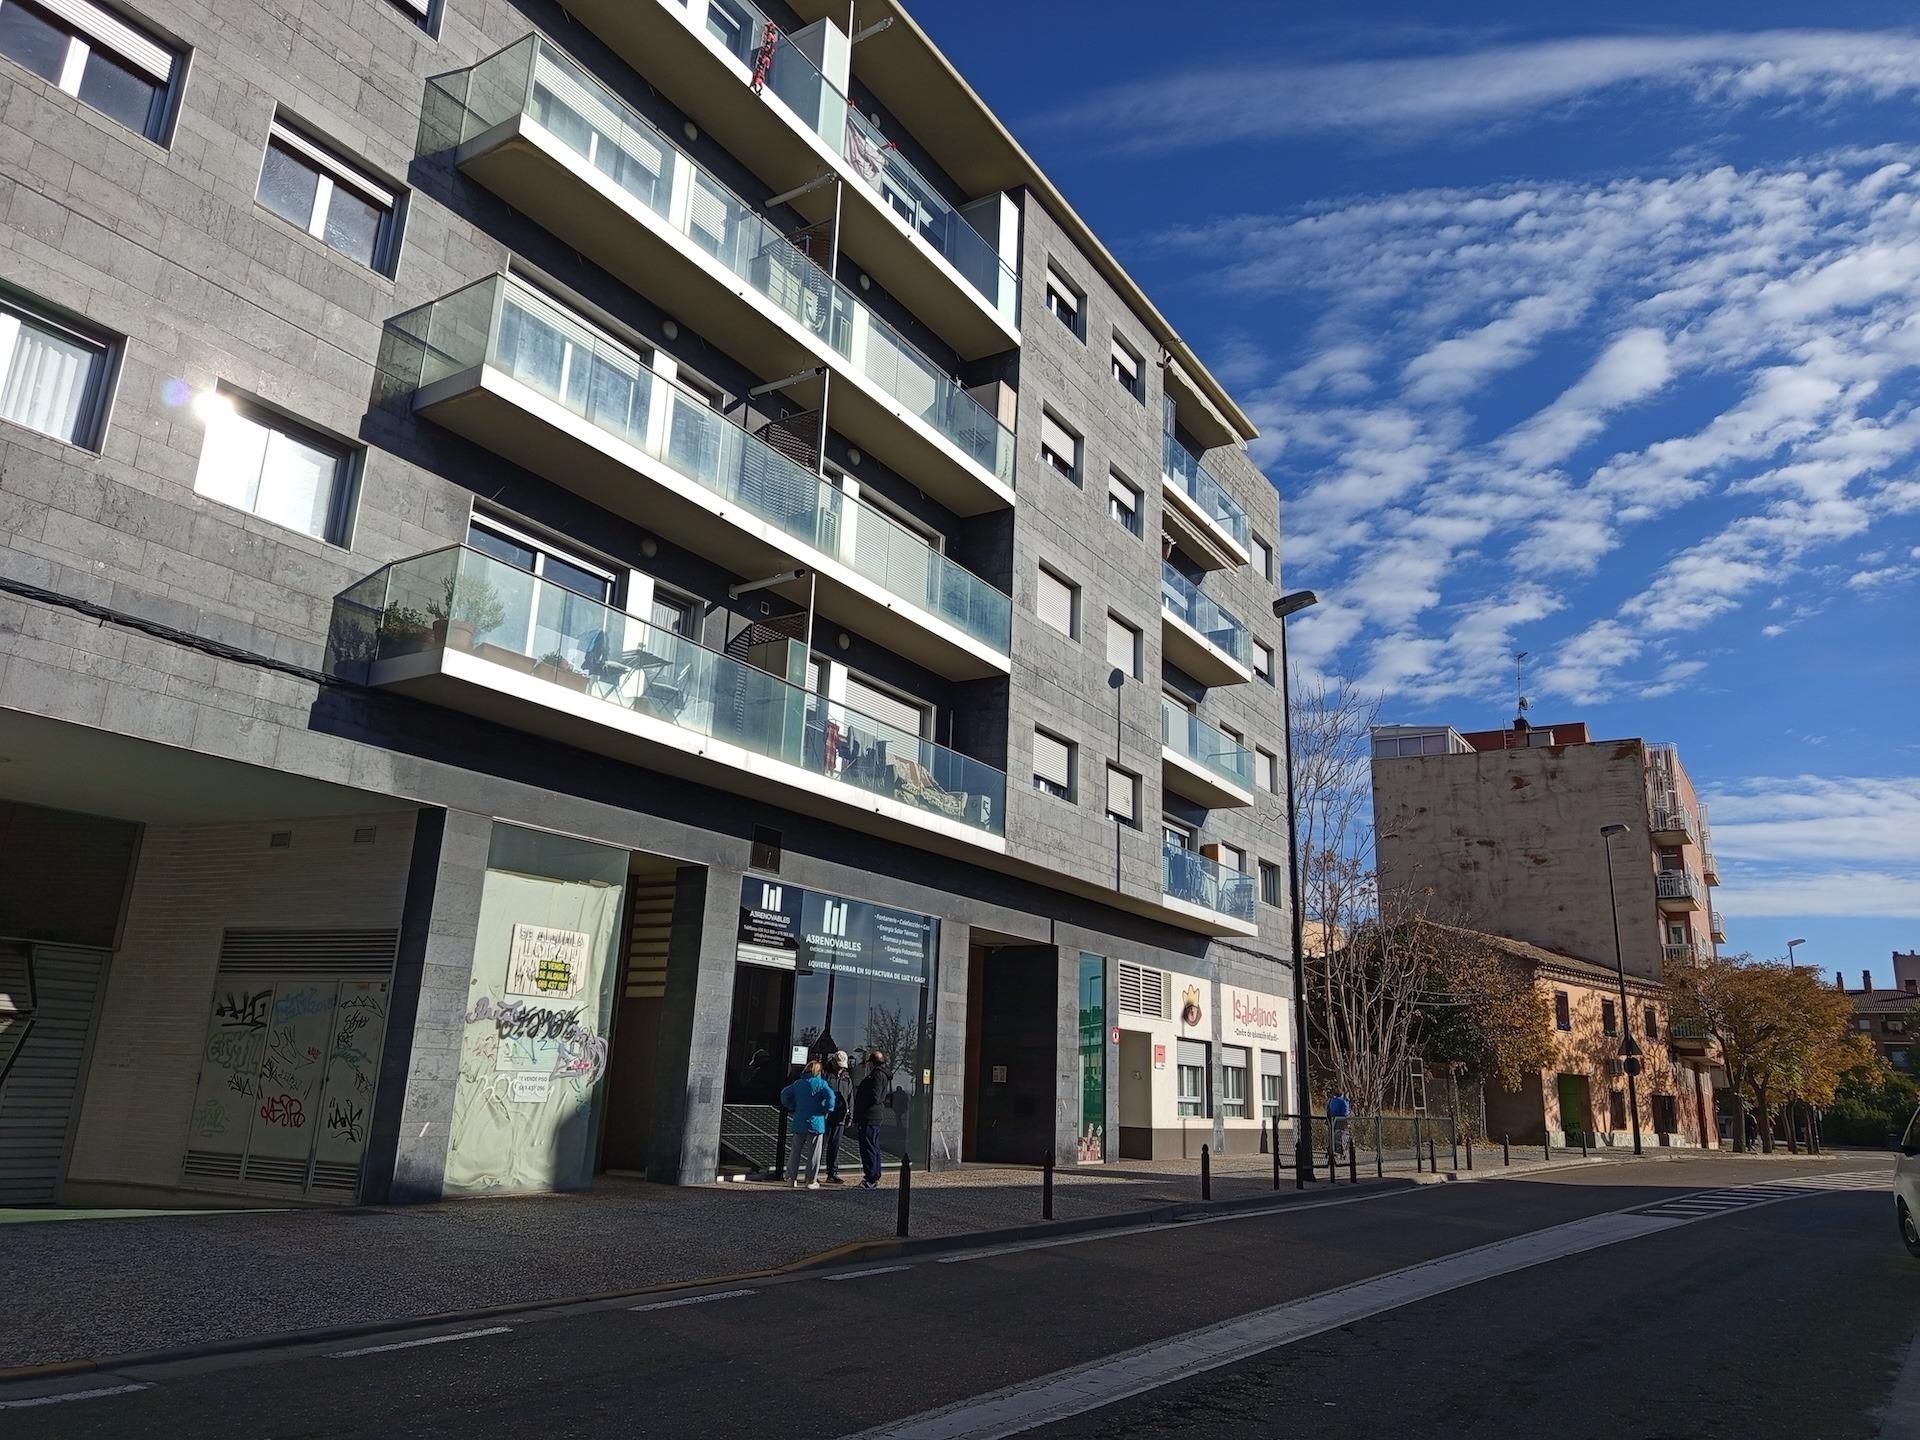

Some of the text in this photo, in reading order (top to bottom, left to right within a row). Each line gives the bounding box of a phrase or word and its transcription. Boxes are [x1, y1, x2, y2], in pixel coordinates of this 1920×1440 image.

[749, 910, 791, 925] A3RENOVABLES
[806, 934, 862, 952] A3RENOVABLES
[808, 960, 830, 970] ¿QUIERE
[831, 964, 856, 974] AHORRAR
[872, 970, 893, 978] FACTURA
